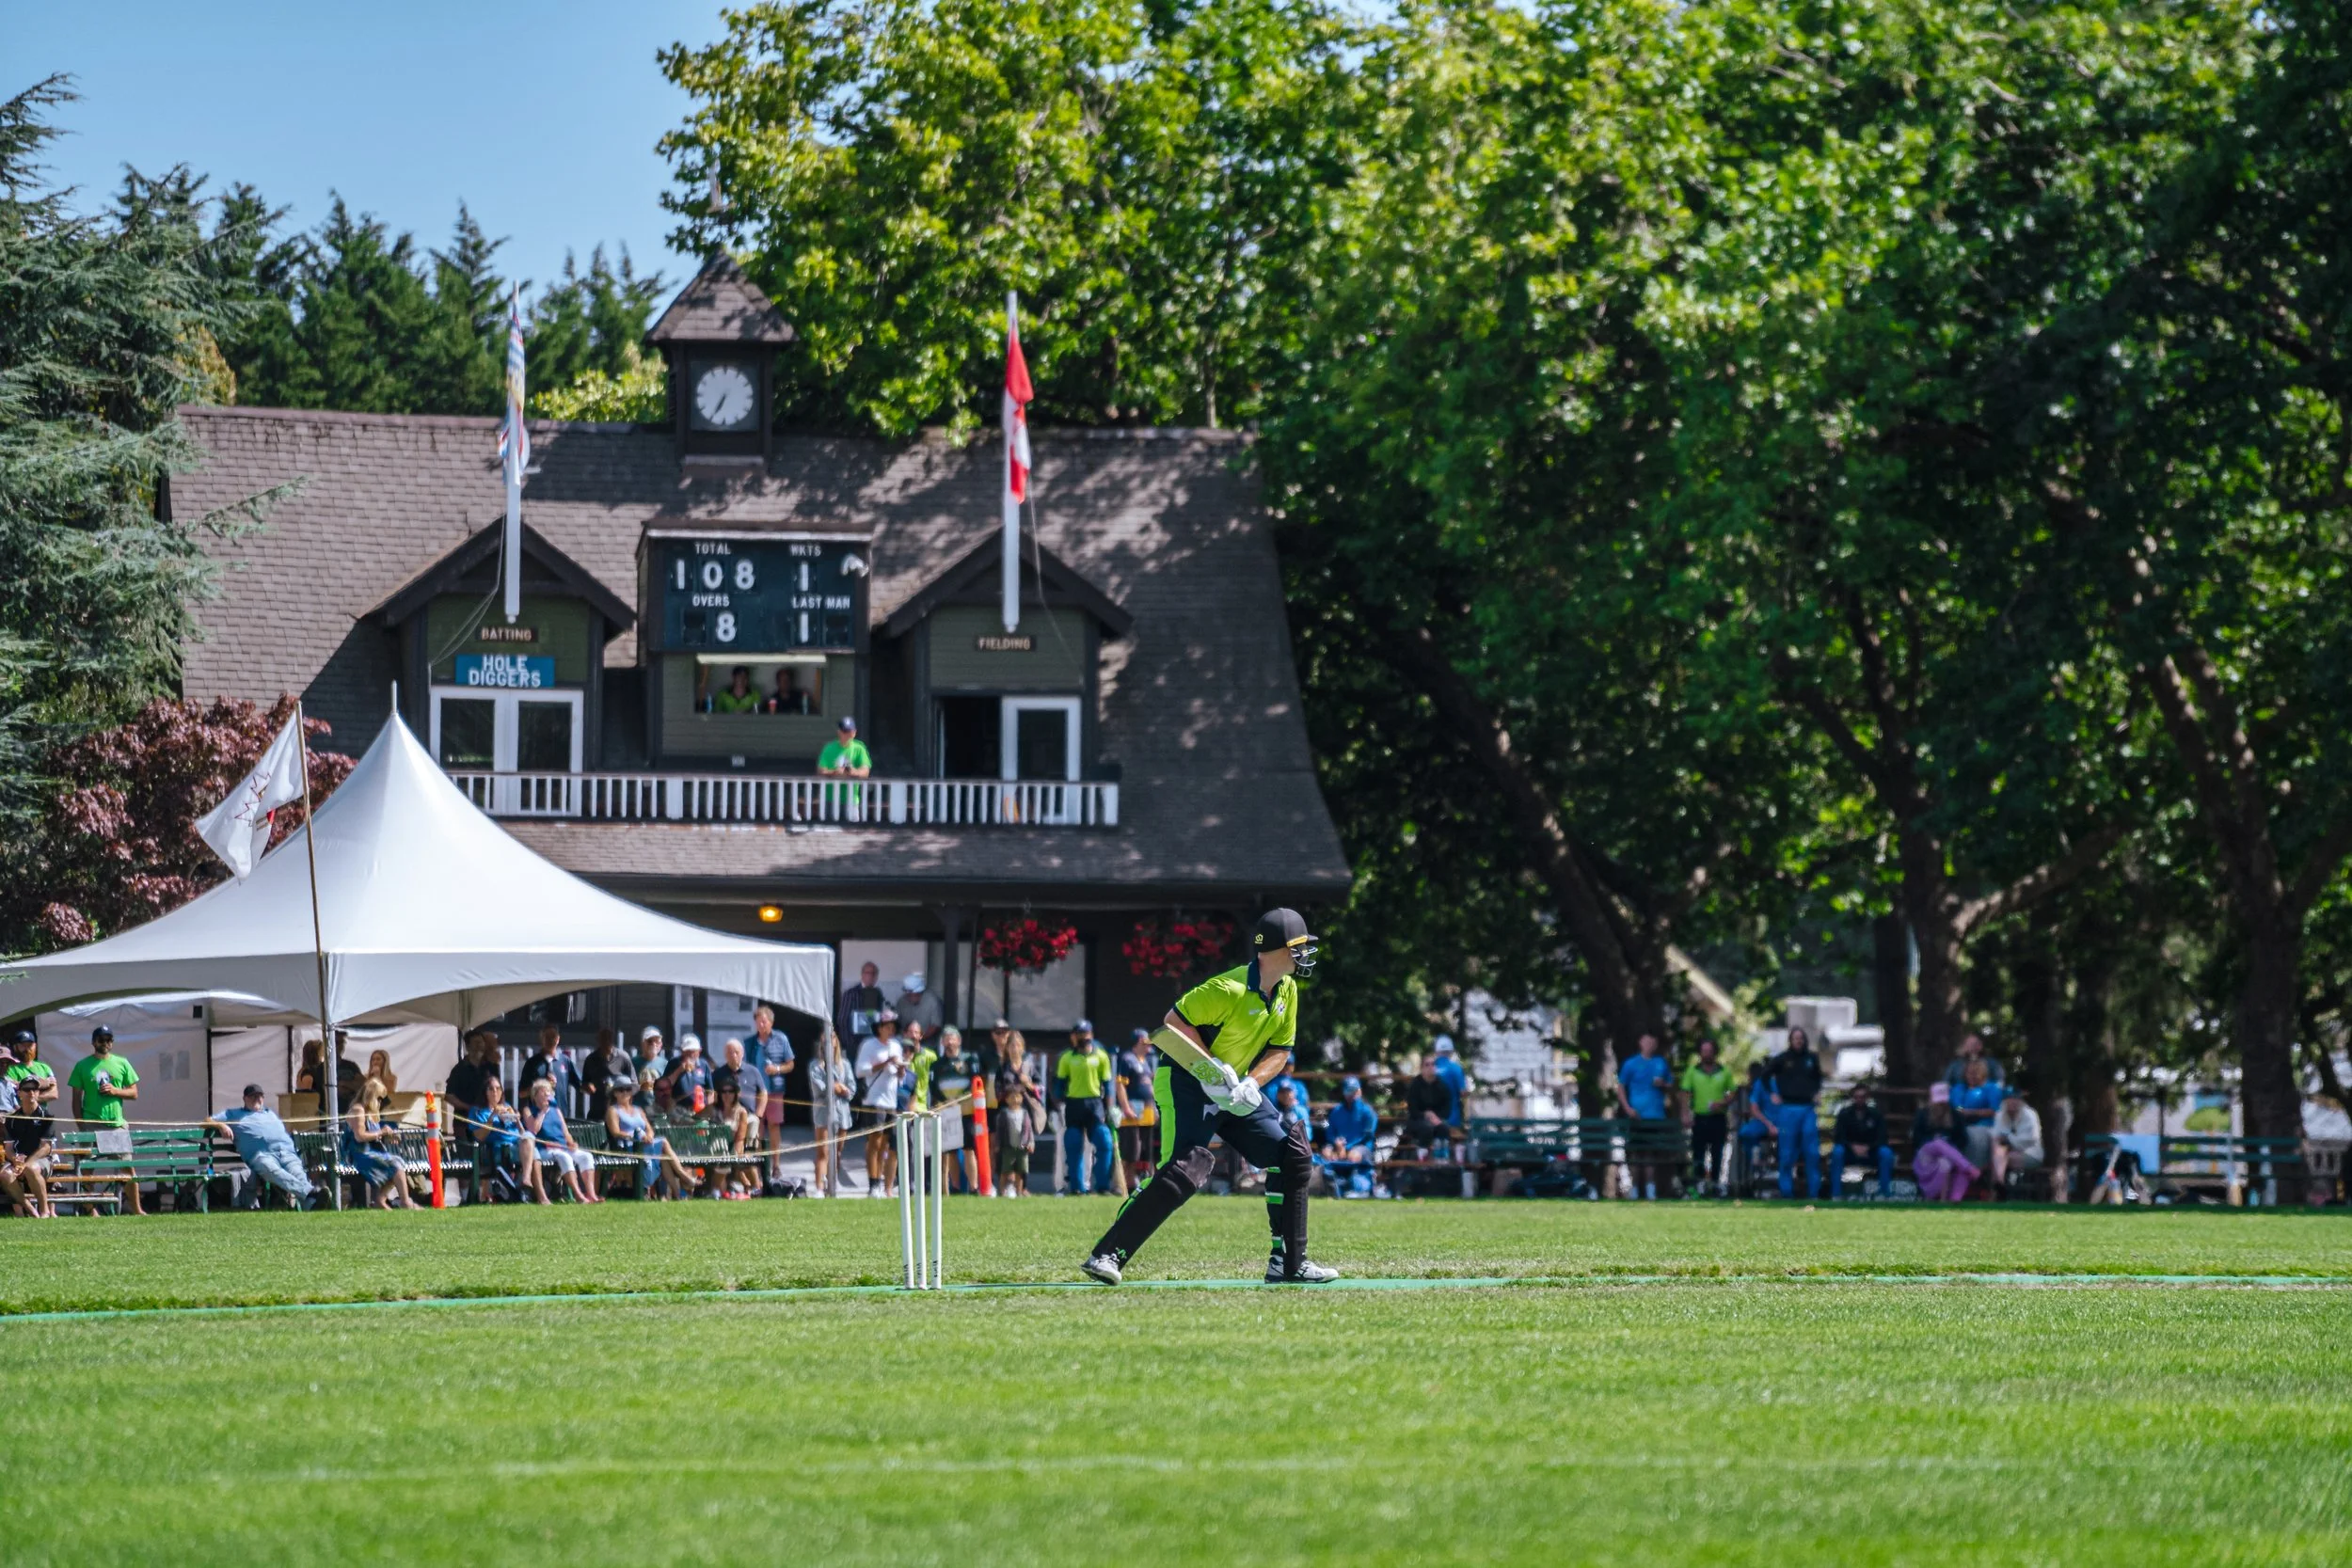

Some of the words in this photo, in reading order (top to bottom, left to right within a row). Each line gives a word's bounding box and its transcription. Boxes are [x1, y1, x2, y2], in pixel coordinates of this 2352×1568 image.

[694, 542, 731, 555] TOTAL
[789, 545, 821, 557] WKTS
[800, 561, 809, 592] 1
[692, 594, 730, 607] OVERS
[792, 596, 821, 609] LAST
[826, 596, 850, 609] MAN
[481, 626, 532, 641] BATTING
[716, 611, 737, 642] 8
[800, 611, 809, 643] 1
[978, 637, 1030, 650] FIELDING
[483, 655, 528, 672] HOLE
[468, 669, 542, 688] DIGGERS
